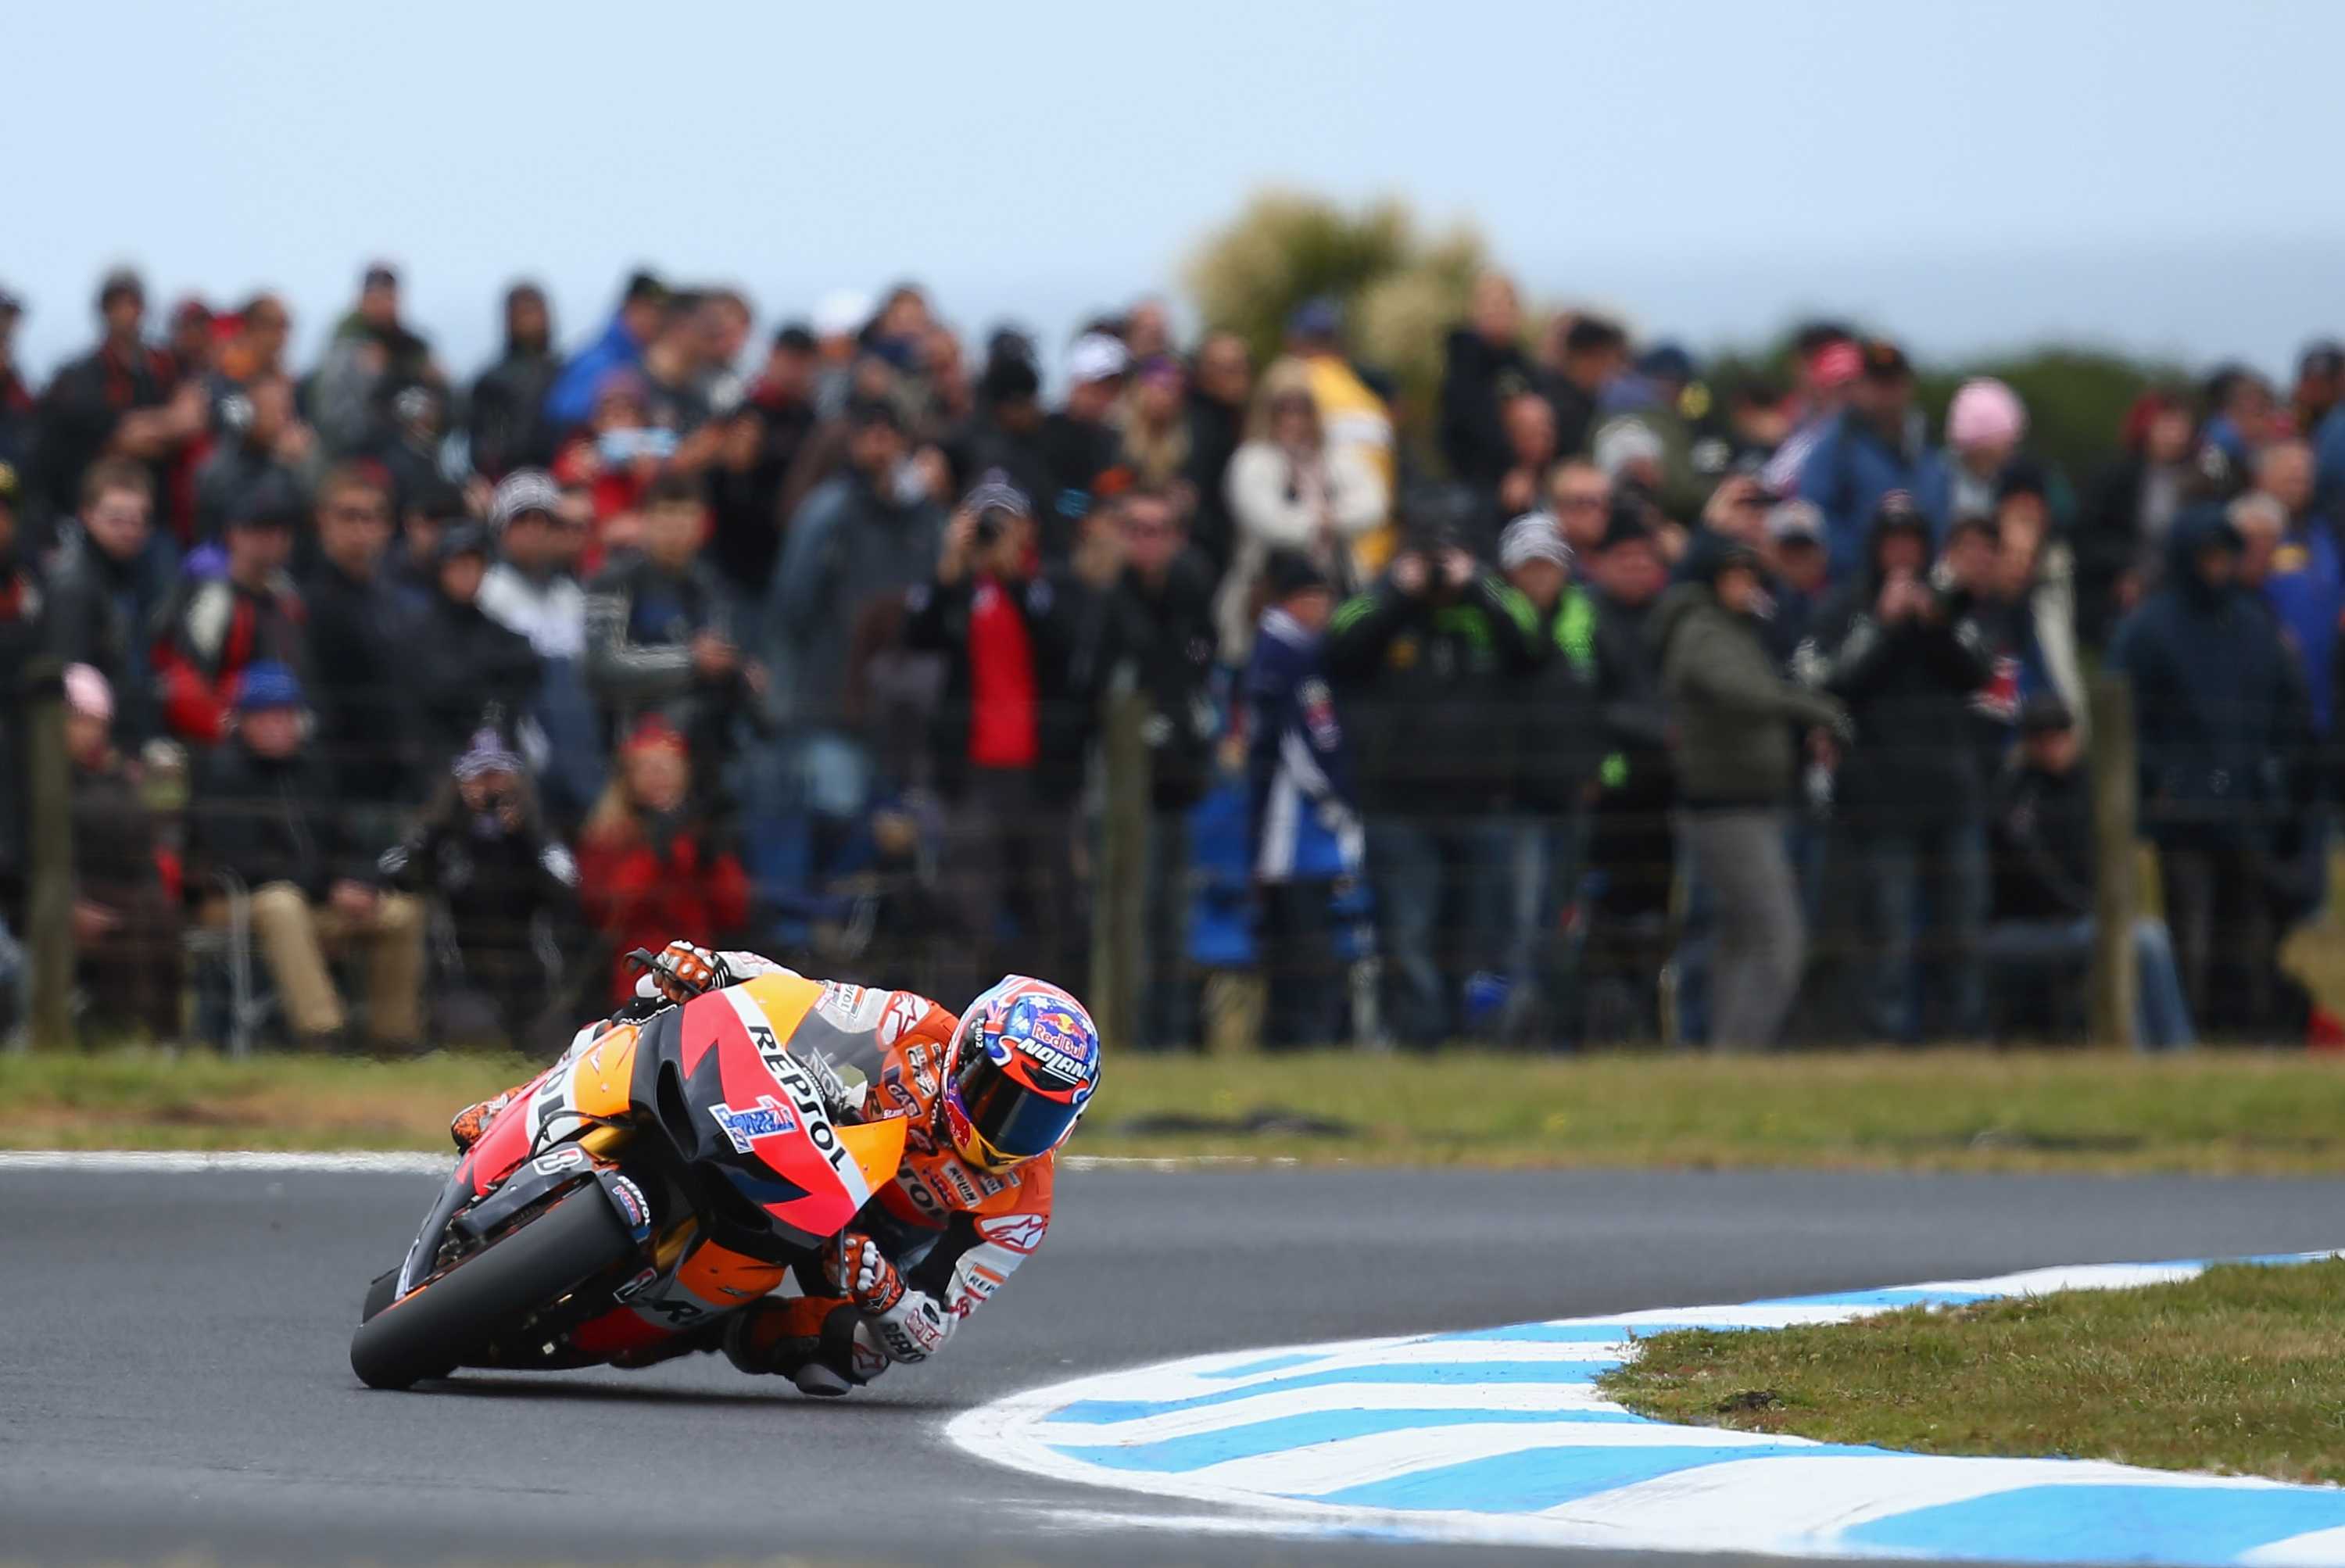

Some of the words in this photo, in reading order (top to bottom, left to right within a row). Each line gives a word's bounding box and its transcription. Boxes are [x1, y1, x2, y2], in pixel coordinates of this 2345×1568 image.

[1018, 1038, 1087, 1080] NOLAN
[1032, 1021, 1062, 1048] Red
[1062, 1036, 1087, 1061] Bull
[747, 1026, 846, 1172] REPSOL
[803, 1067, 827, 1104] HONDA
[618, 1176, 650, 1226] REPSOL
